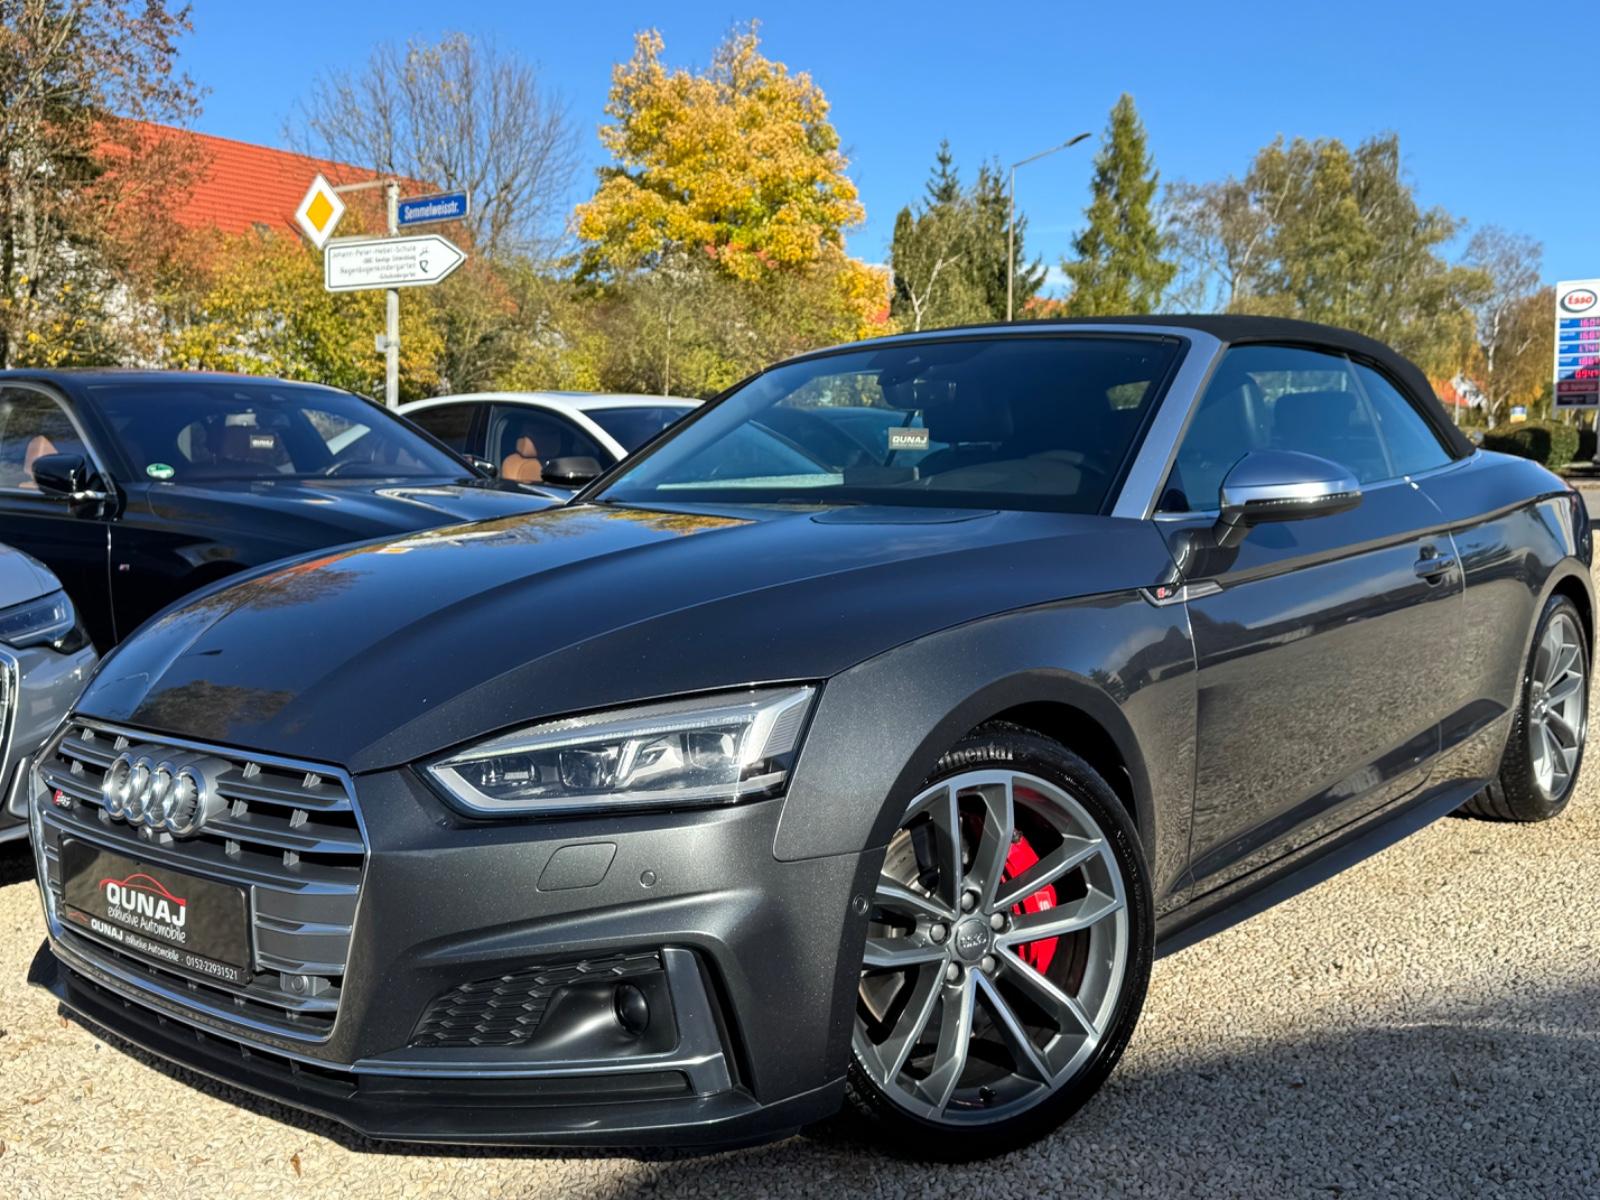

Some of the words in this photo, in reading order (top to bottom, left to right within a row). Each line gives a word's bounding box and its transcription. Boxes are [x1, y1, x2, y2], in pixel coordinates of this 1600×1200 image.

[404, 201, 459, 220] Semmelweisstr.
[1567, 294, 1593, 305] Esso
[892, 434, 928, 444] QUNAJ
[106, 882, 187, 928] QUNAJ
[107, 904, 139, 928] exklusive
[140, 916, 186, 944] Automobile
[91, 918, 123, 941] QUNAJ
[148, 942, 179, 962] Automobile
[185, 955, 238, 981] 0152-22931521
